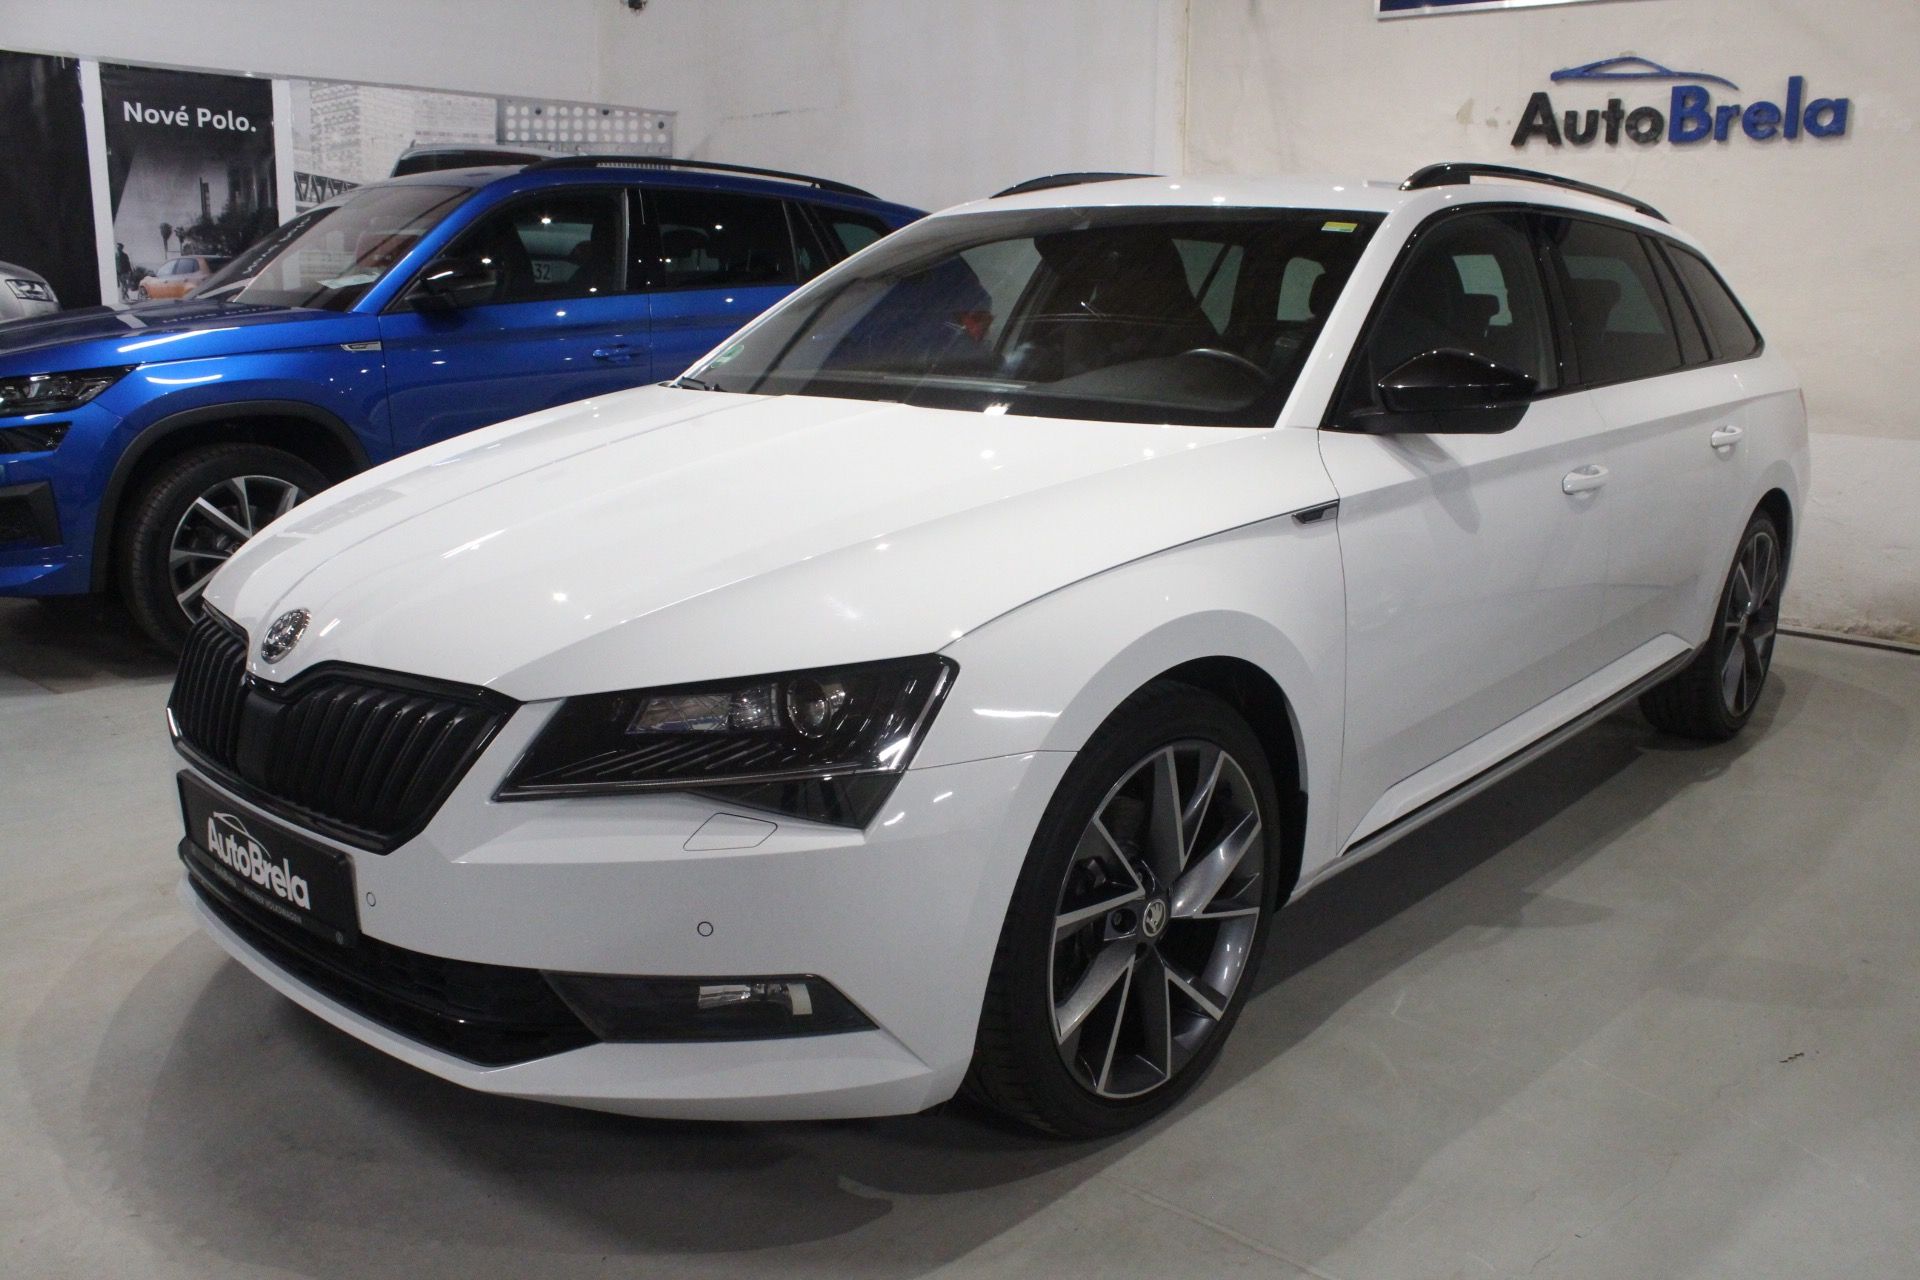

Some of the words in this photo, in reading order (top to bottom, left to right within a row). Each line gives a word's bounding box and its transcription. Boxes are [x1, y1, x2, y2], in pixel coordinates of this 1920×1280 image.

[123, 101, 189, 127] Nové
[197, 107, 257, 133] Polo.
[1510, 75, 1849, 146] AutoBrela
[207, 816, 311, 910] AutoBrela
